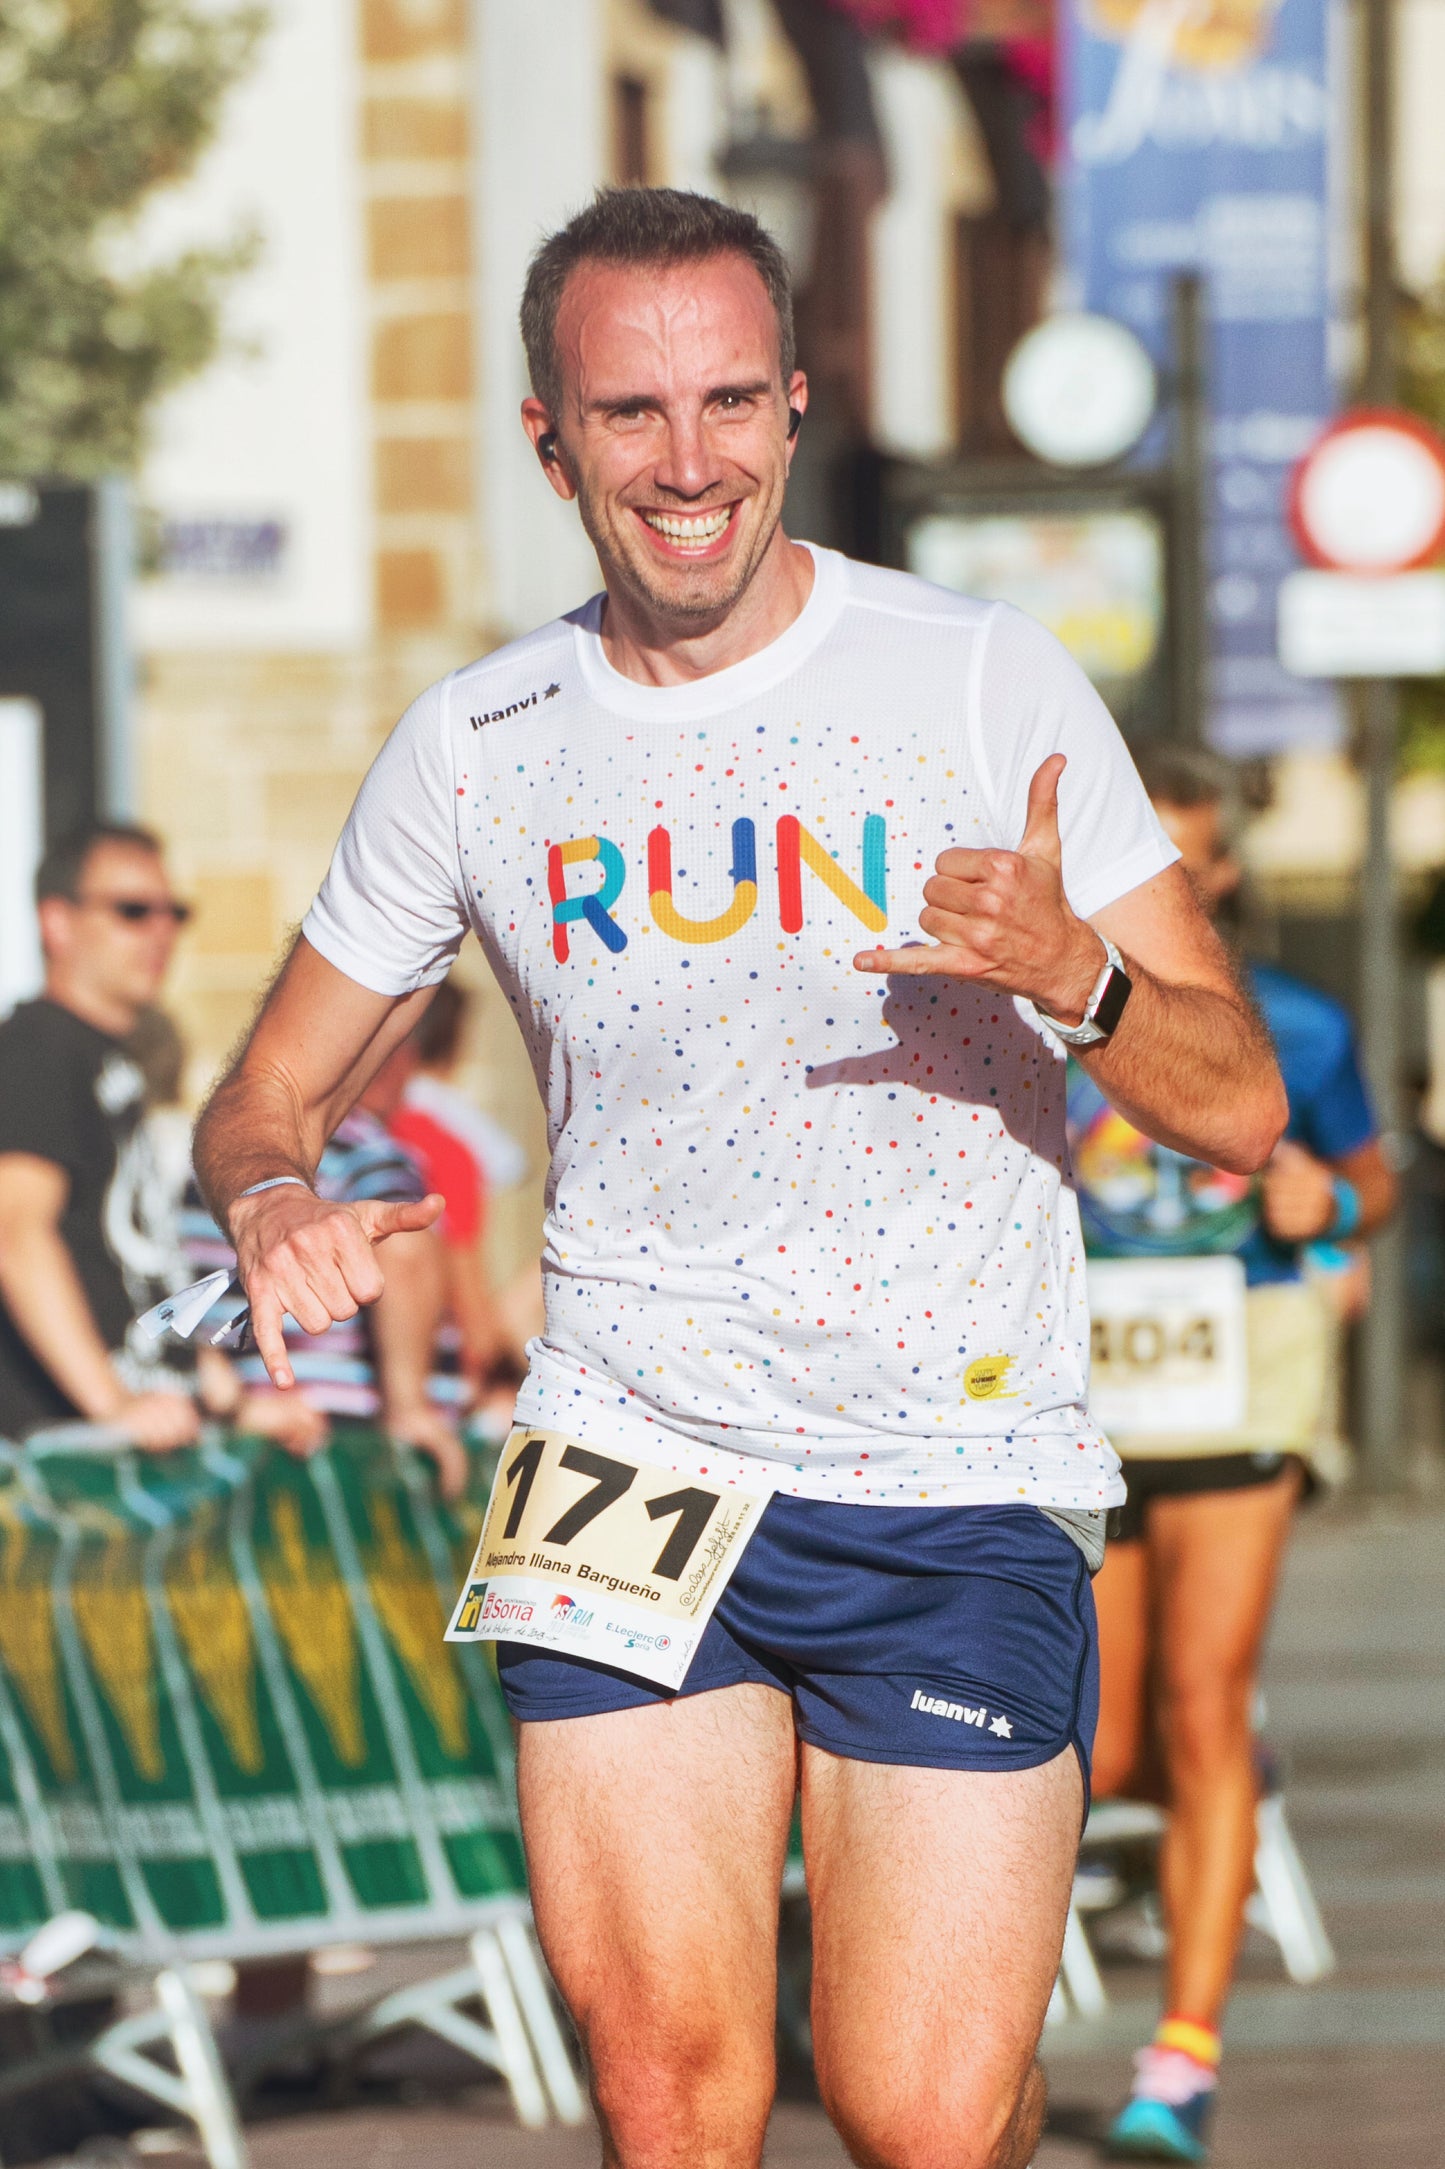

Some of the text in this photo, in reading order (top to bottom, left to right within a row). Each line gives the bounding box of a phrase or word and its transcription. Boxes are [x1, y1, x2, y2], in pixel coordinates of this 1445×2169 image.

[470, 692, 538, 731] luanvi
[548, 814, 888, 964] RUN
[506, 1440, 721, 1581] 171
[485, 1551, 662, 1602] Alejandro Illana Bargueño
[492, 1598, 534, 1621] Soria
[605, 1622, 655, 1644] E.Leclerc
[624, 1638, 651, 1651] Soria
[910, 1690, 987, 1728] luanvi
